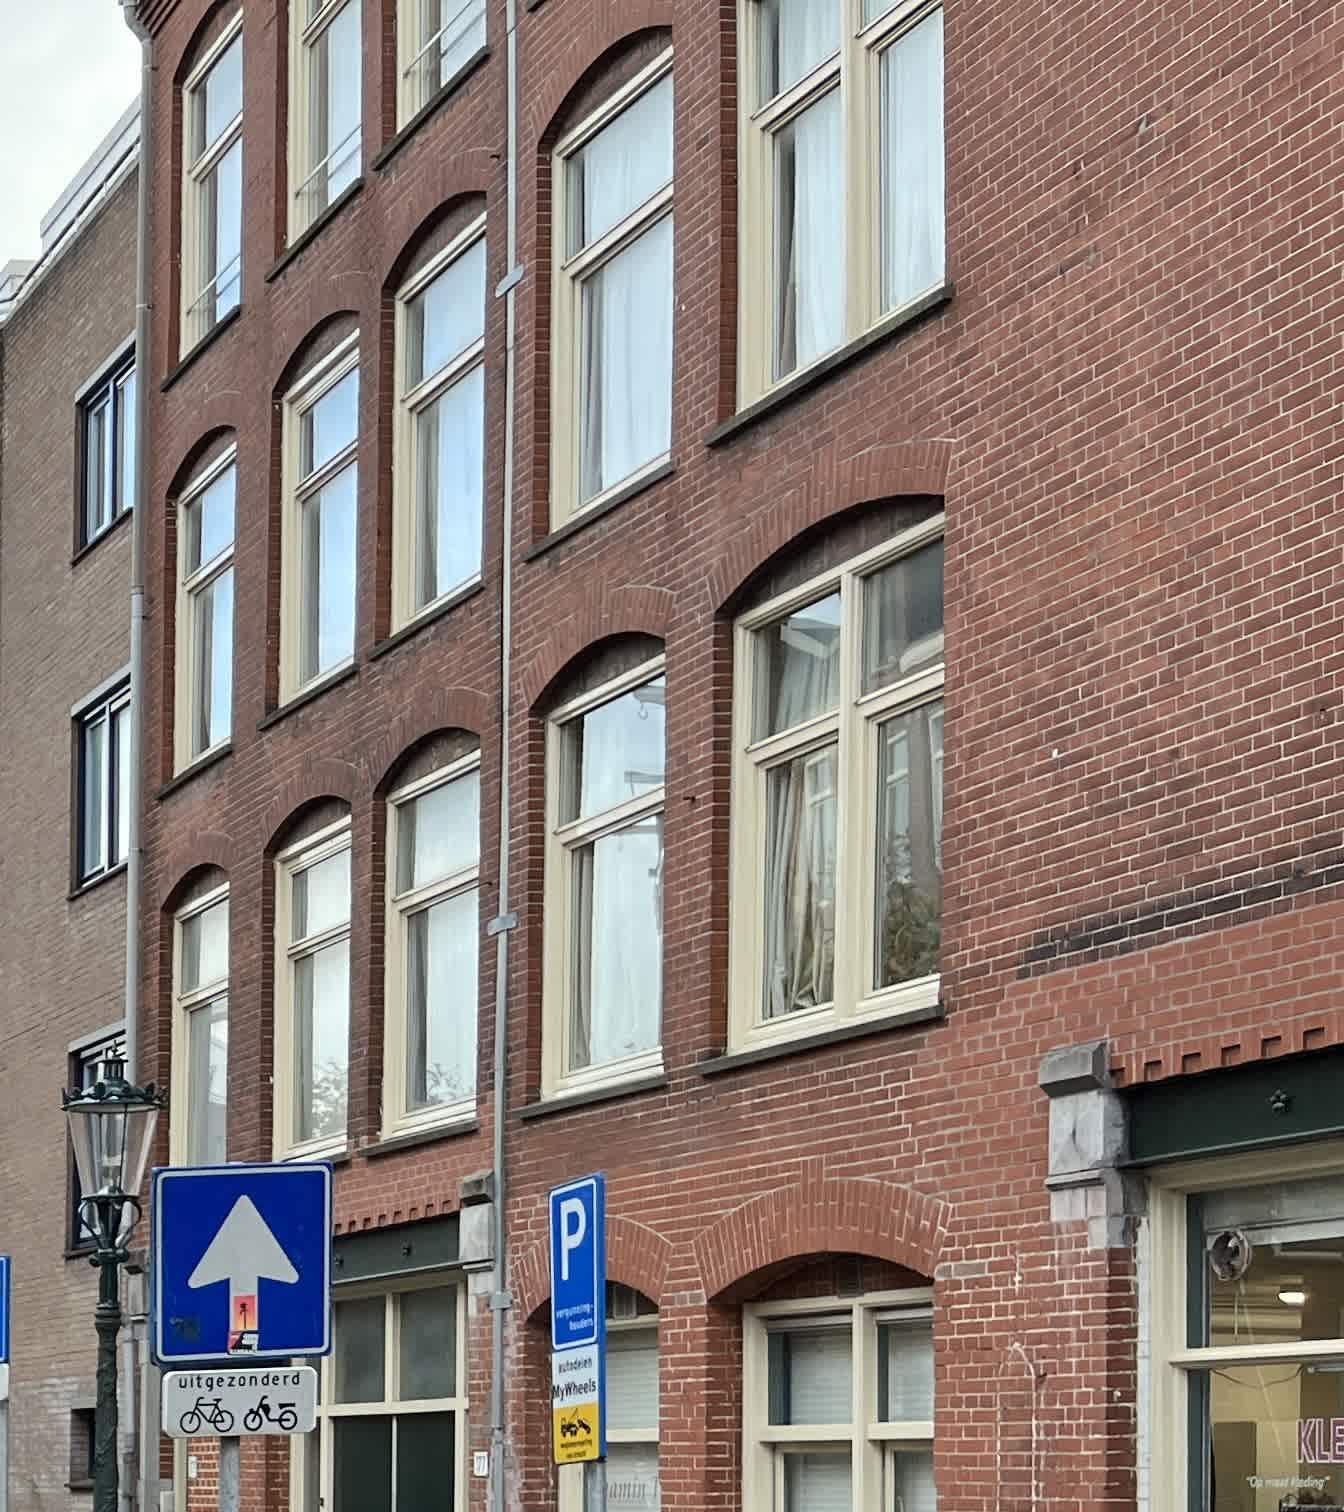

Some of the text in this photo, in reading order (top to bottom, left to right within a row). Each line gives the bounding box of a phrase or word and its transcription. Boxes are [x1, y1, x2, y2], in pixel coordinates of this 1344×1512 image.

[560, 1197, 586, 1281] P
[178, 1372, 301, 1392] uitgezonderd
[552, 1379, 597, 1401] MyWheels
